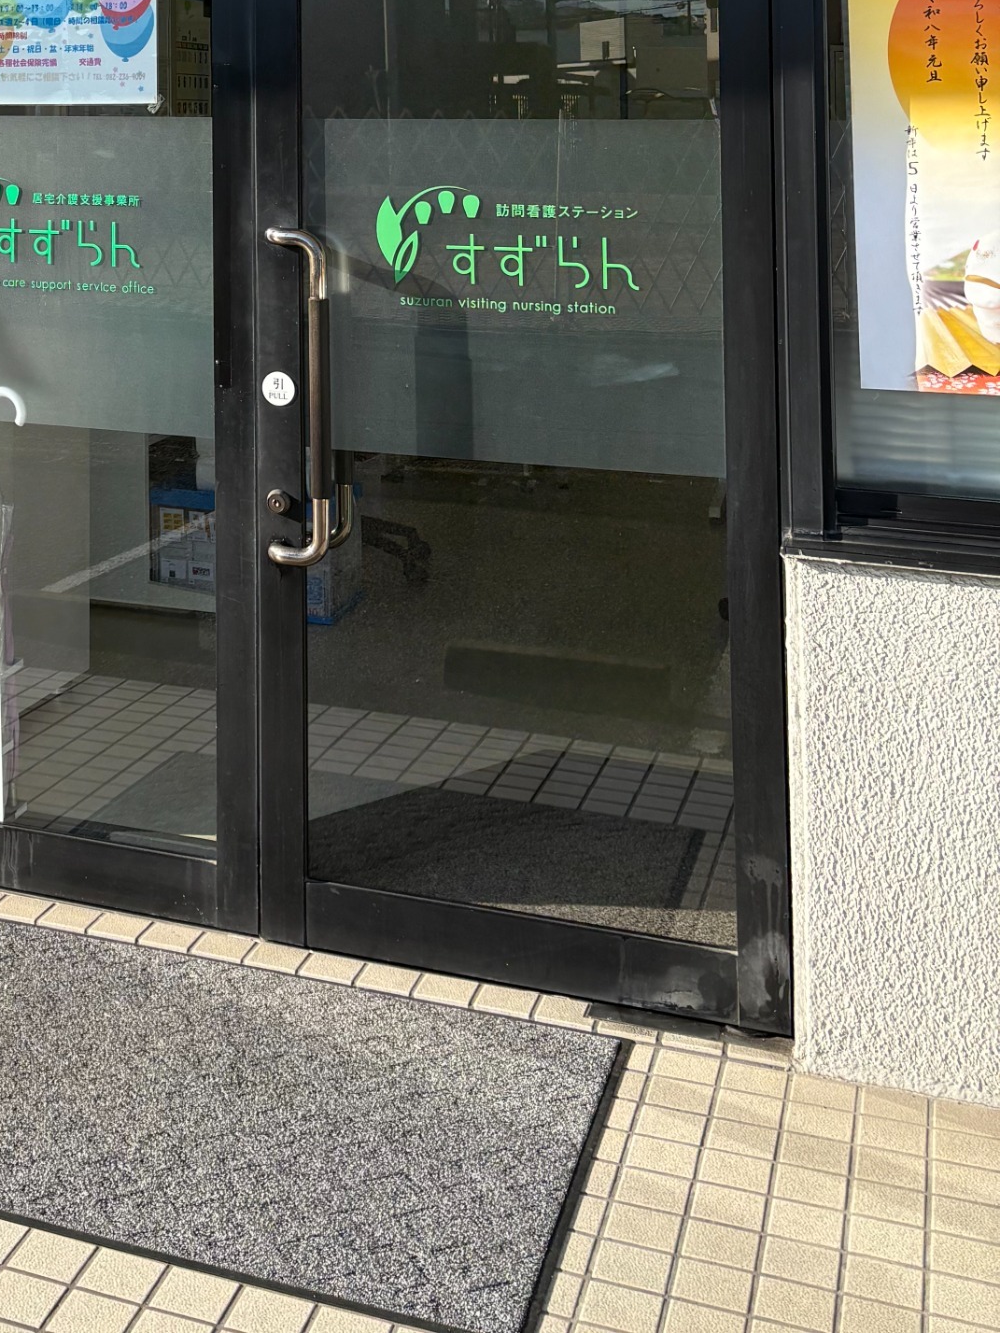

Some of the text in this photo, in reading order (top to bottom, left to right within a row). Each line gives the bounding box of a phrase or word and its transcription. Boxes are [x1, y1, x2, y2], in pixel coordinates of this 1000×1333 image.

[32, 192, 140, 207] 居宅介護支援事業所
[495, 203, 639, 219] 訪問看護ステーション
[446, 233, 640, 291] すずらん
[2, 278, 26, 288] care
[30, 279, 72, 292] support
[76, 281, 117, 293] service
[121, 280, 155, 294] office
[400, 296, 616, 315] suzuran visiting nursing station
[273, 377, 283, 390] 引
[269, 392, 288, 400] PULL
